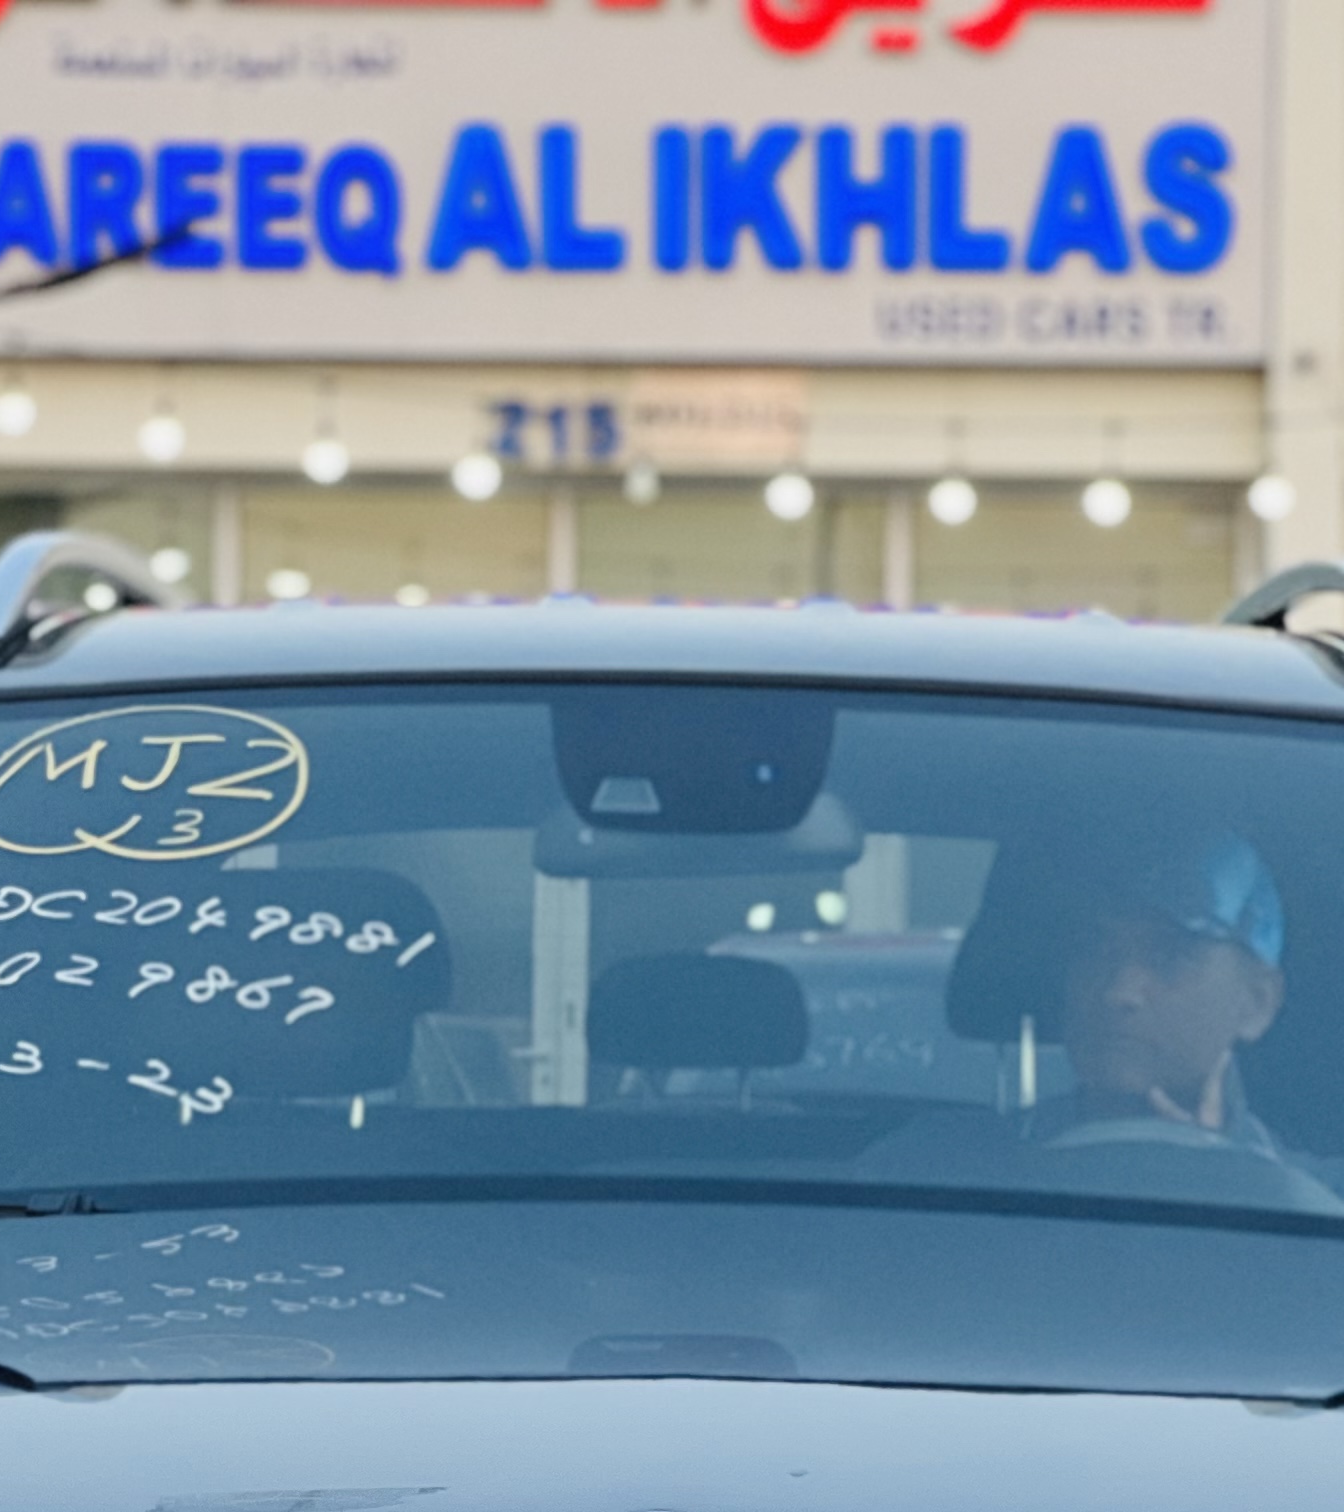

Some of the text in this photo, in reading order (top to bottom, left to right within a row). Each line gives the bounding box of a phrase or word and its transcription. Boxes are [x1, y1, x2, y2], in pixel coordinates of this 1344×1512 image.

[426, 120, 626, 273] AL
[653, 118, 1236, 275] IKHLAS
[875, 299, 1005, 344] USED
[1018, 298, 1147, 343] CARS
